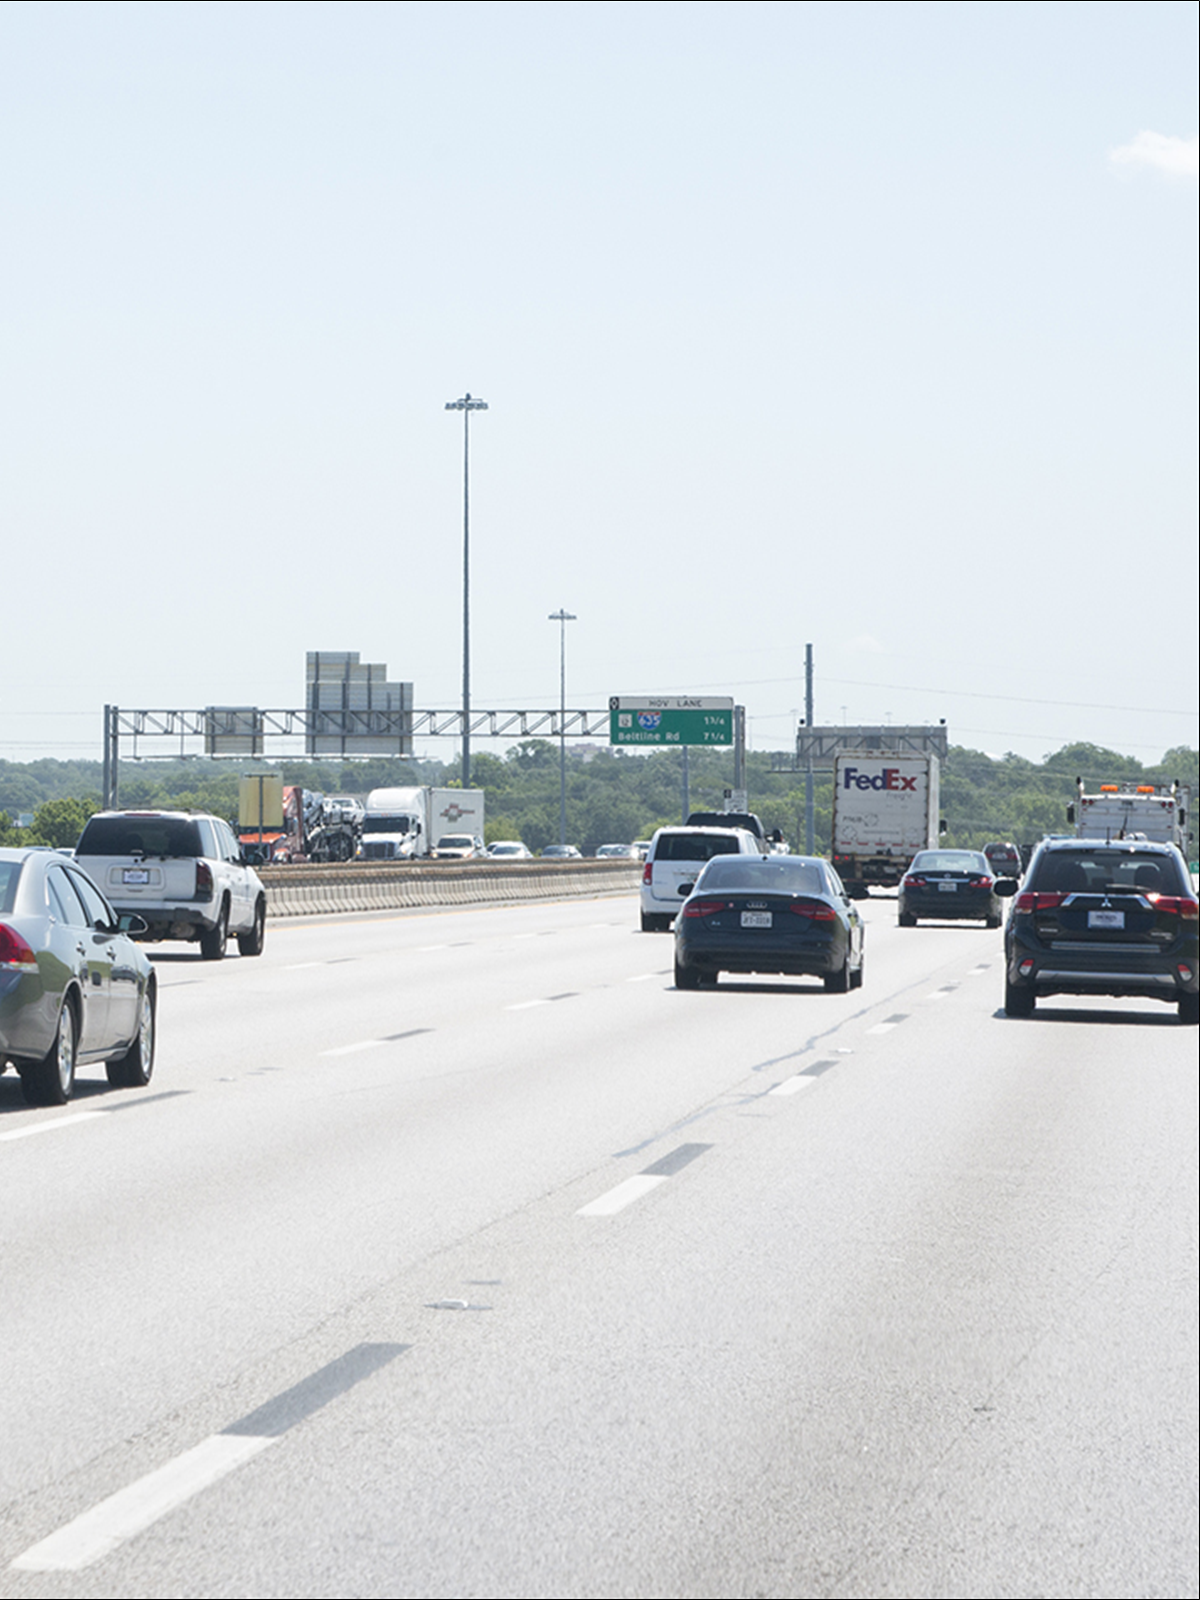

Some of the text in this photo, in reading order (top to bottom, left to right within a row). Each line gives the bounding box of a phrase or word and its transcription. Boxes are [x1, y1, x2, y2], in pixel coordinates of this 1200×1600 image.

[640, 717, 660, 726] 635
[618, 732, 680, 741] Beltline Rd
[844, 767, 917, 791] FedEx
